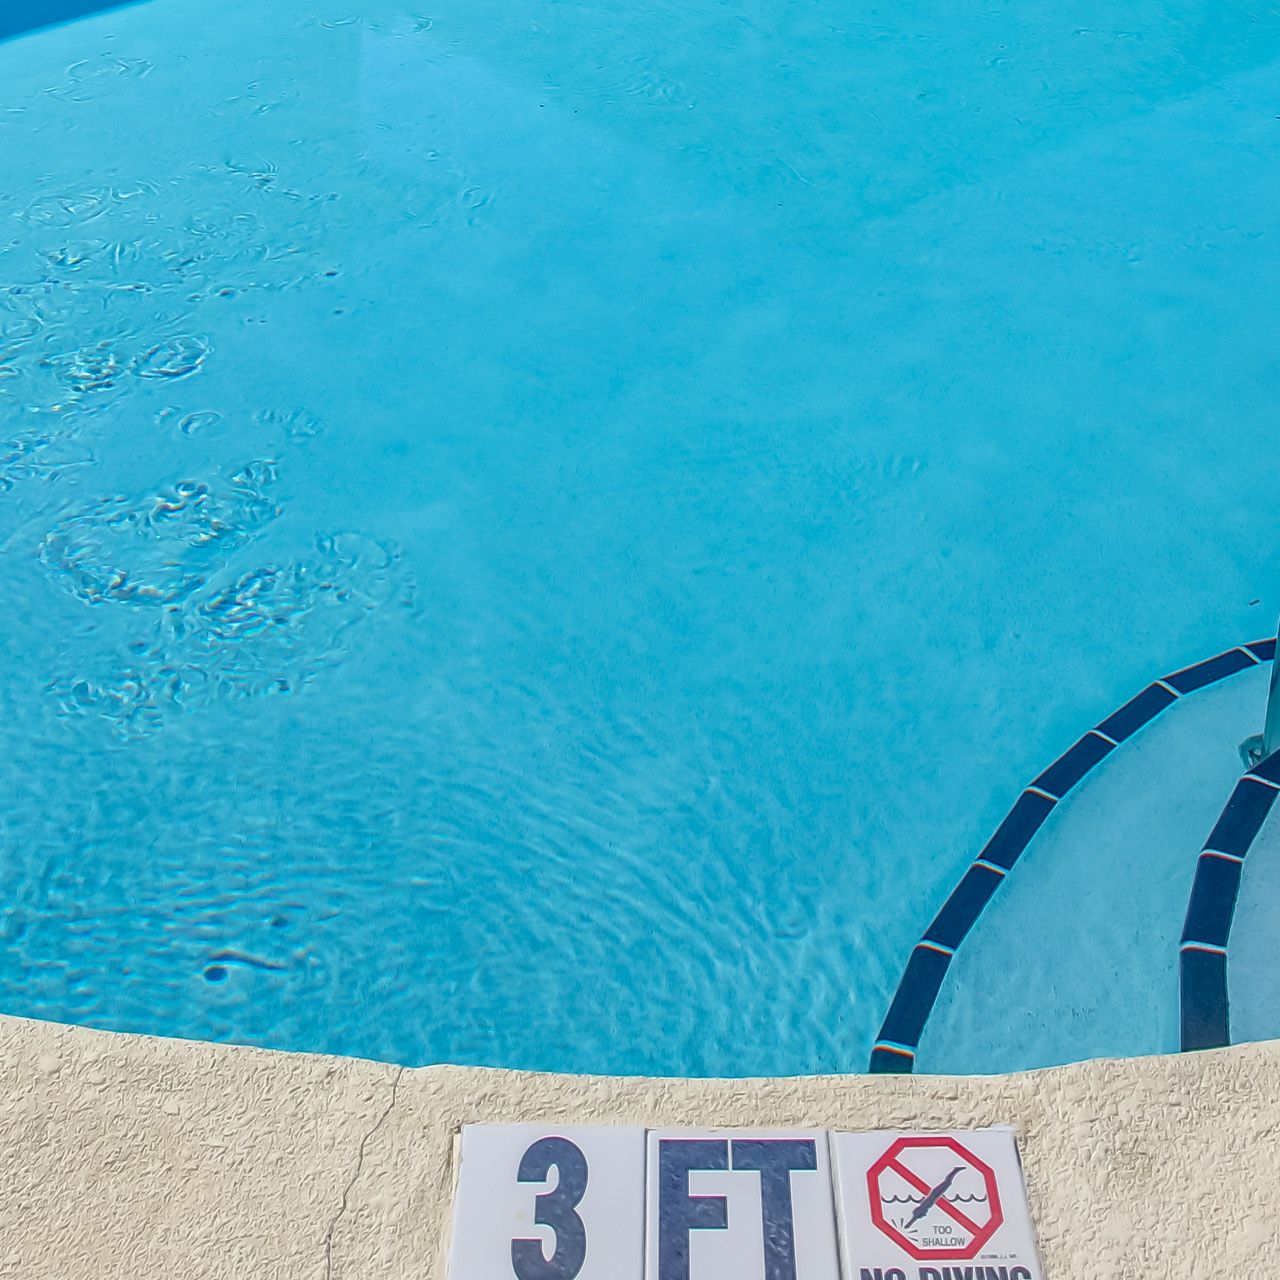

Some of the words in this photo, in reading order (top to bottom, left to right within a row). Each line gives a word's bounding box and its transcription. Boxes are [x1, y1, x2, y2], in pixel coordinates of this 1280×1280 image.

[509, 1136, 589, 1280] 3
[659, 1138, 818, 1280] FT
[932, 1225, 952, 1235] TOO
[922, 1237, 966, 1247] SHALLOW
